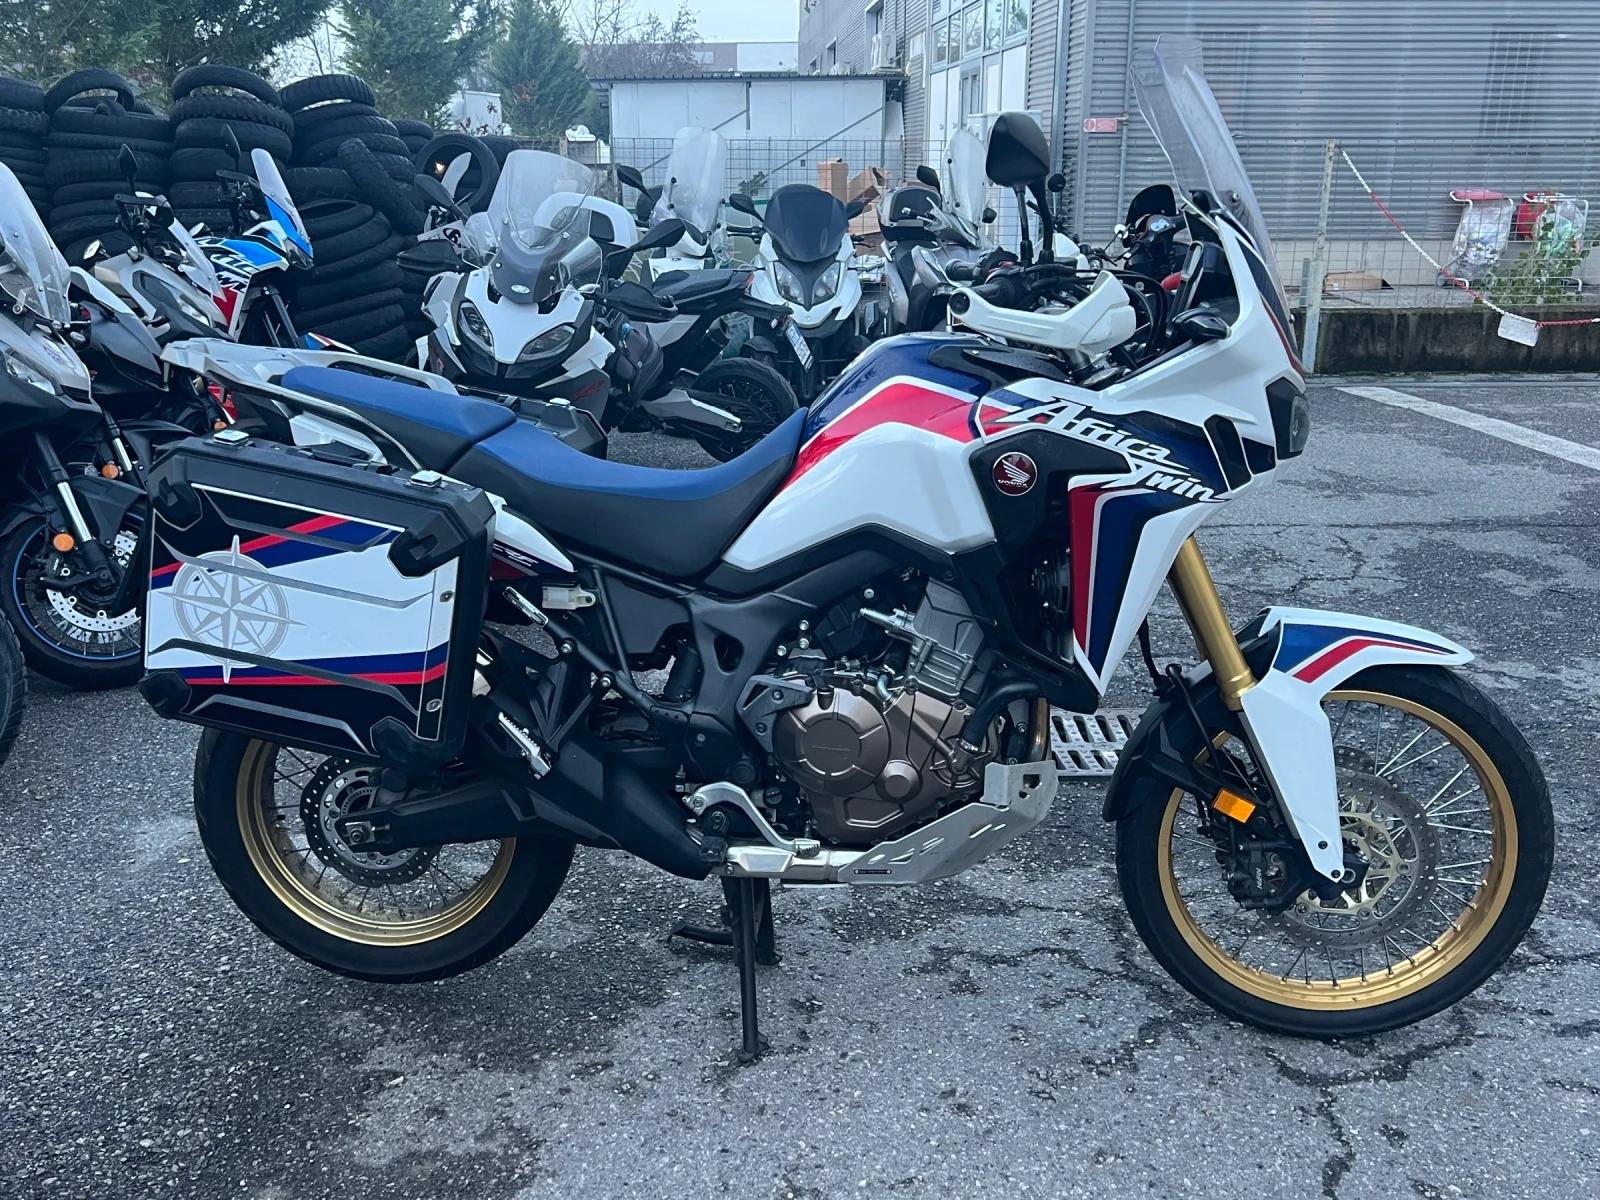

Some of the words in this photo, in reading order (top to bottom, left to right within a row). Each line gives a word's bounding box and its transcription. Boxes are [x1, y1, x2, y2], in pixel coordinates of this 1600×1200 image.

[996, 398, 1190, 470] Africa
[997, 479, 1029, 489] HONDA
[1101, 460, 1231, 502] Twin
